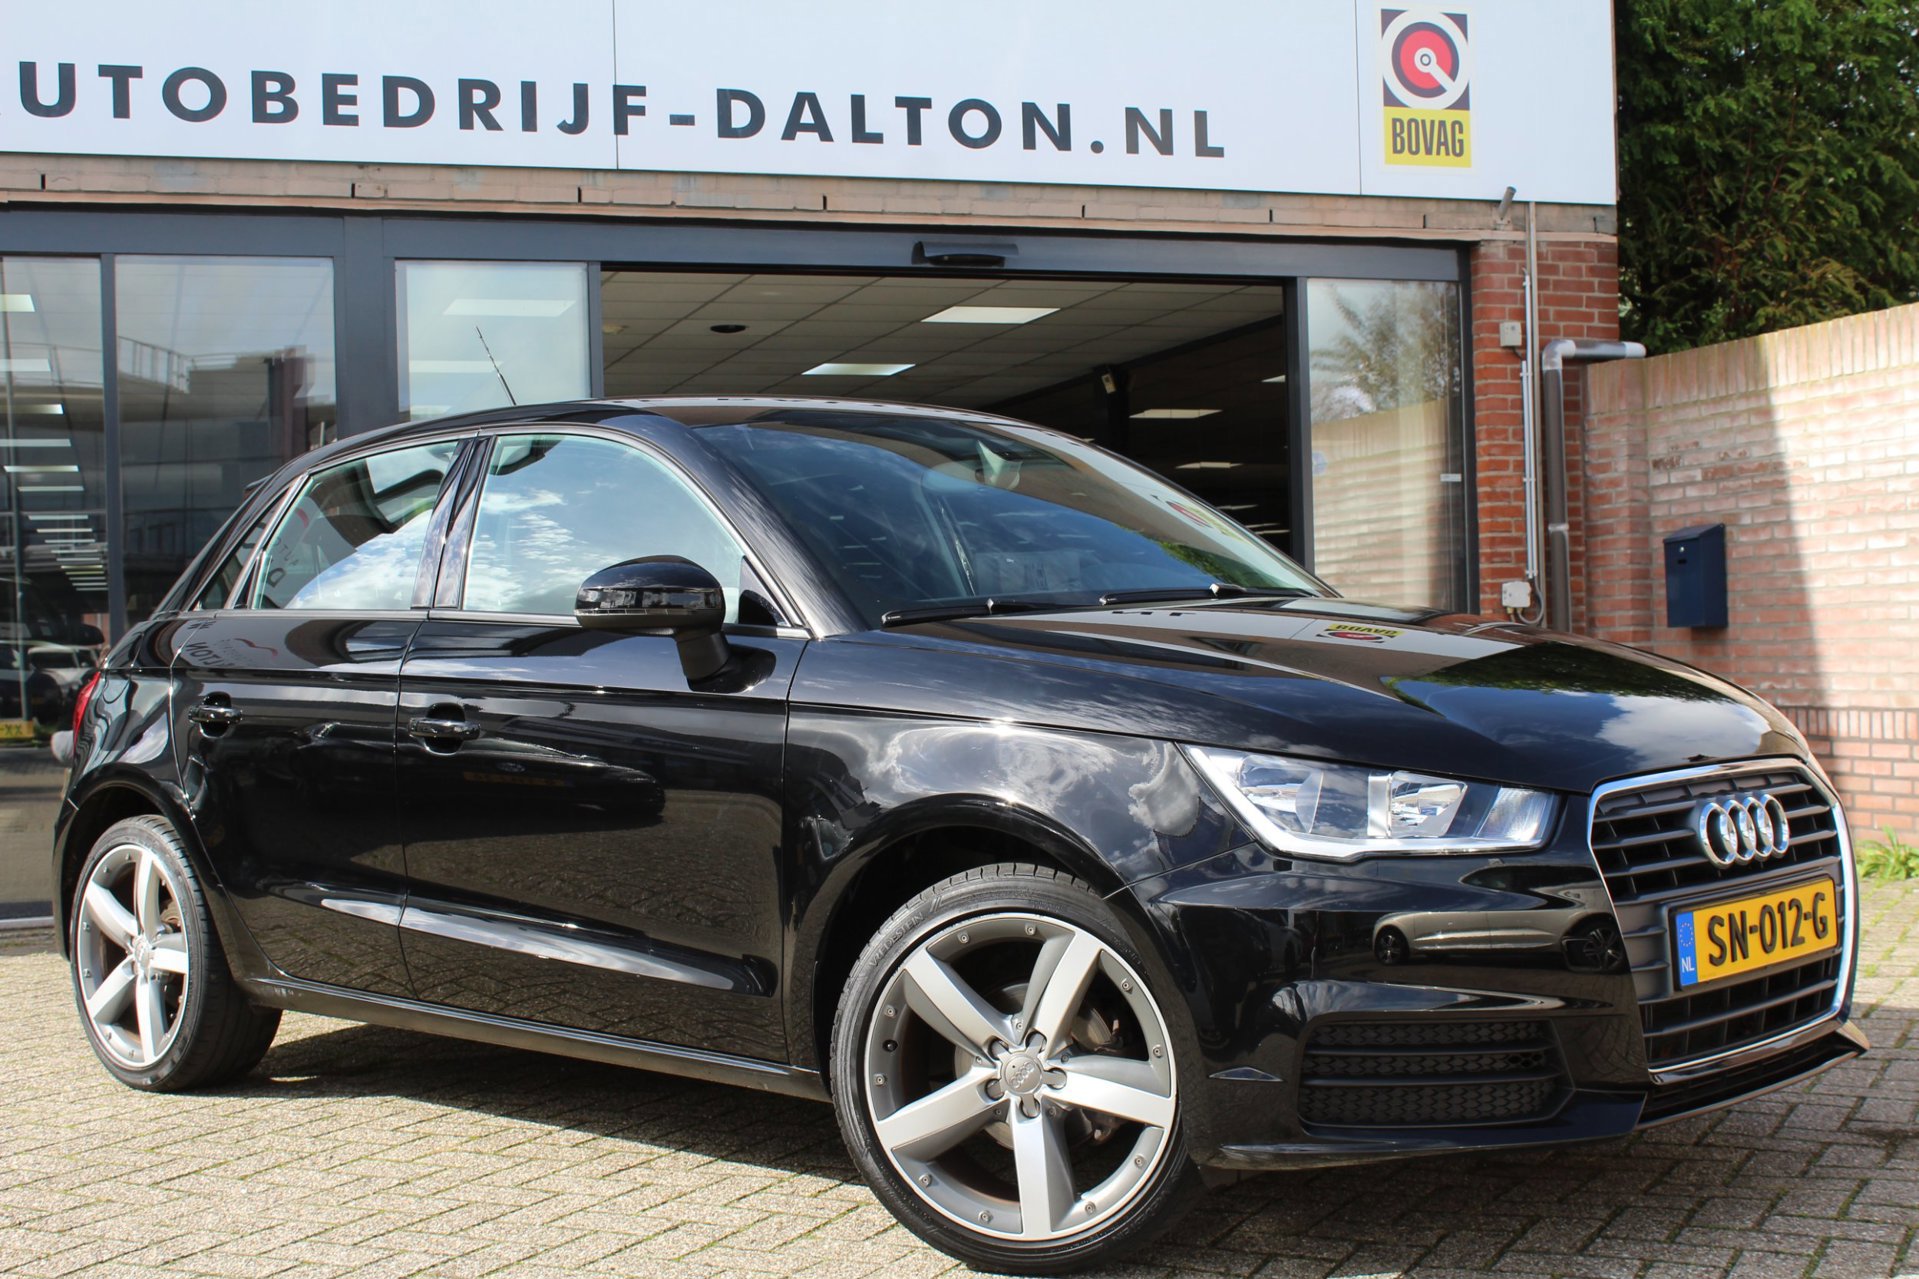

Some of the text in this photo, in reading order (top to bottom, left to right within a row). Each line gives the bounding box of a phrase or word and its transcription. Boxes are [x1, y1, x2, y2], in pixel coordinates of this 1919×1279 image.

[1, 61, 1225, 158] UTOBEDRIJF-DALTON.NL
[1391, 117, 1465, 158] BOVAG
[1708, 892, 1829, 966] SN-012-G
[1681, 957, 1695, 974] NL
